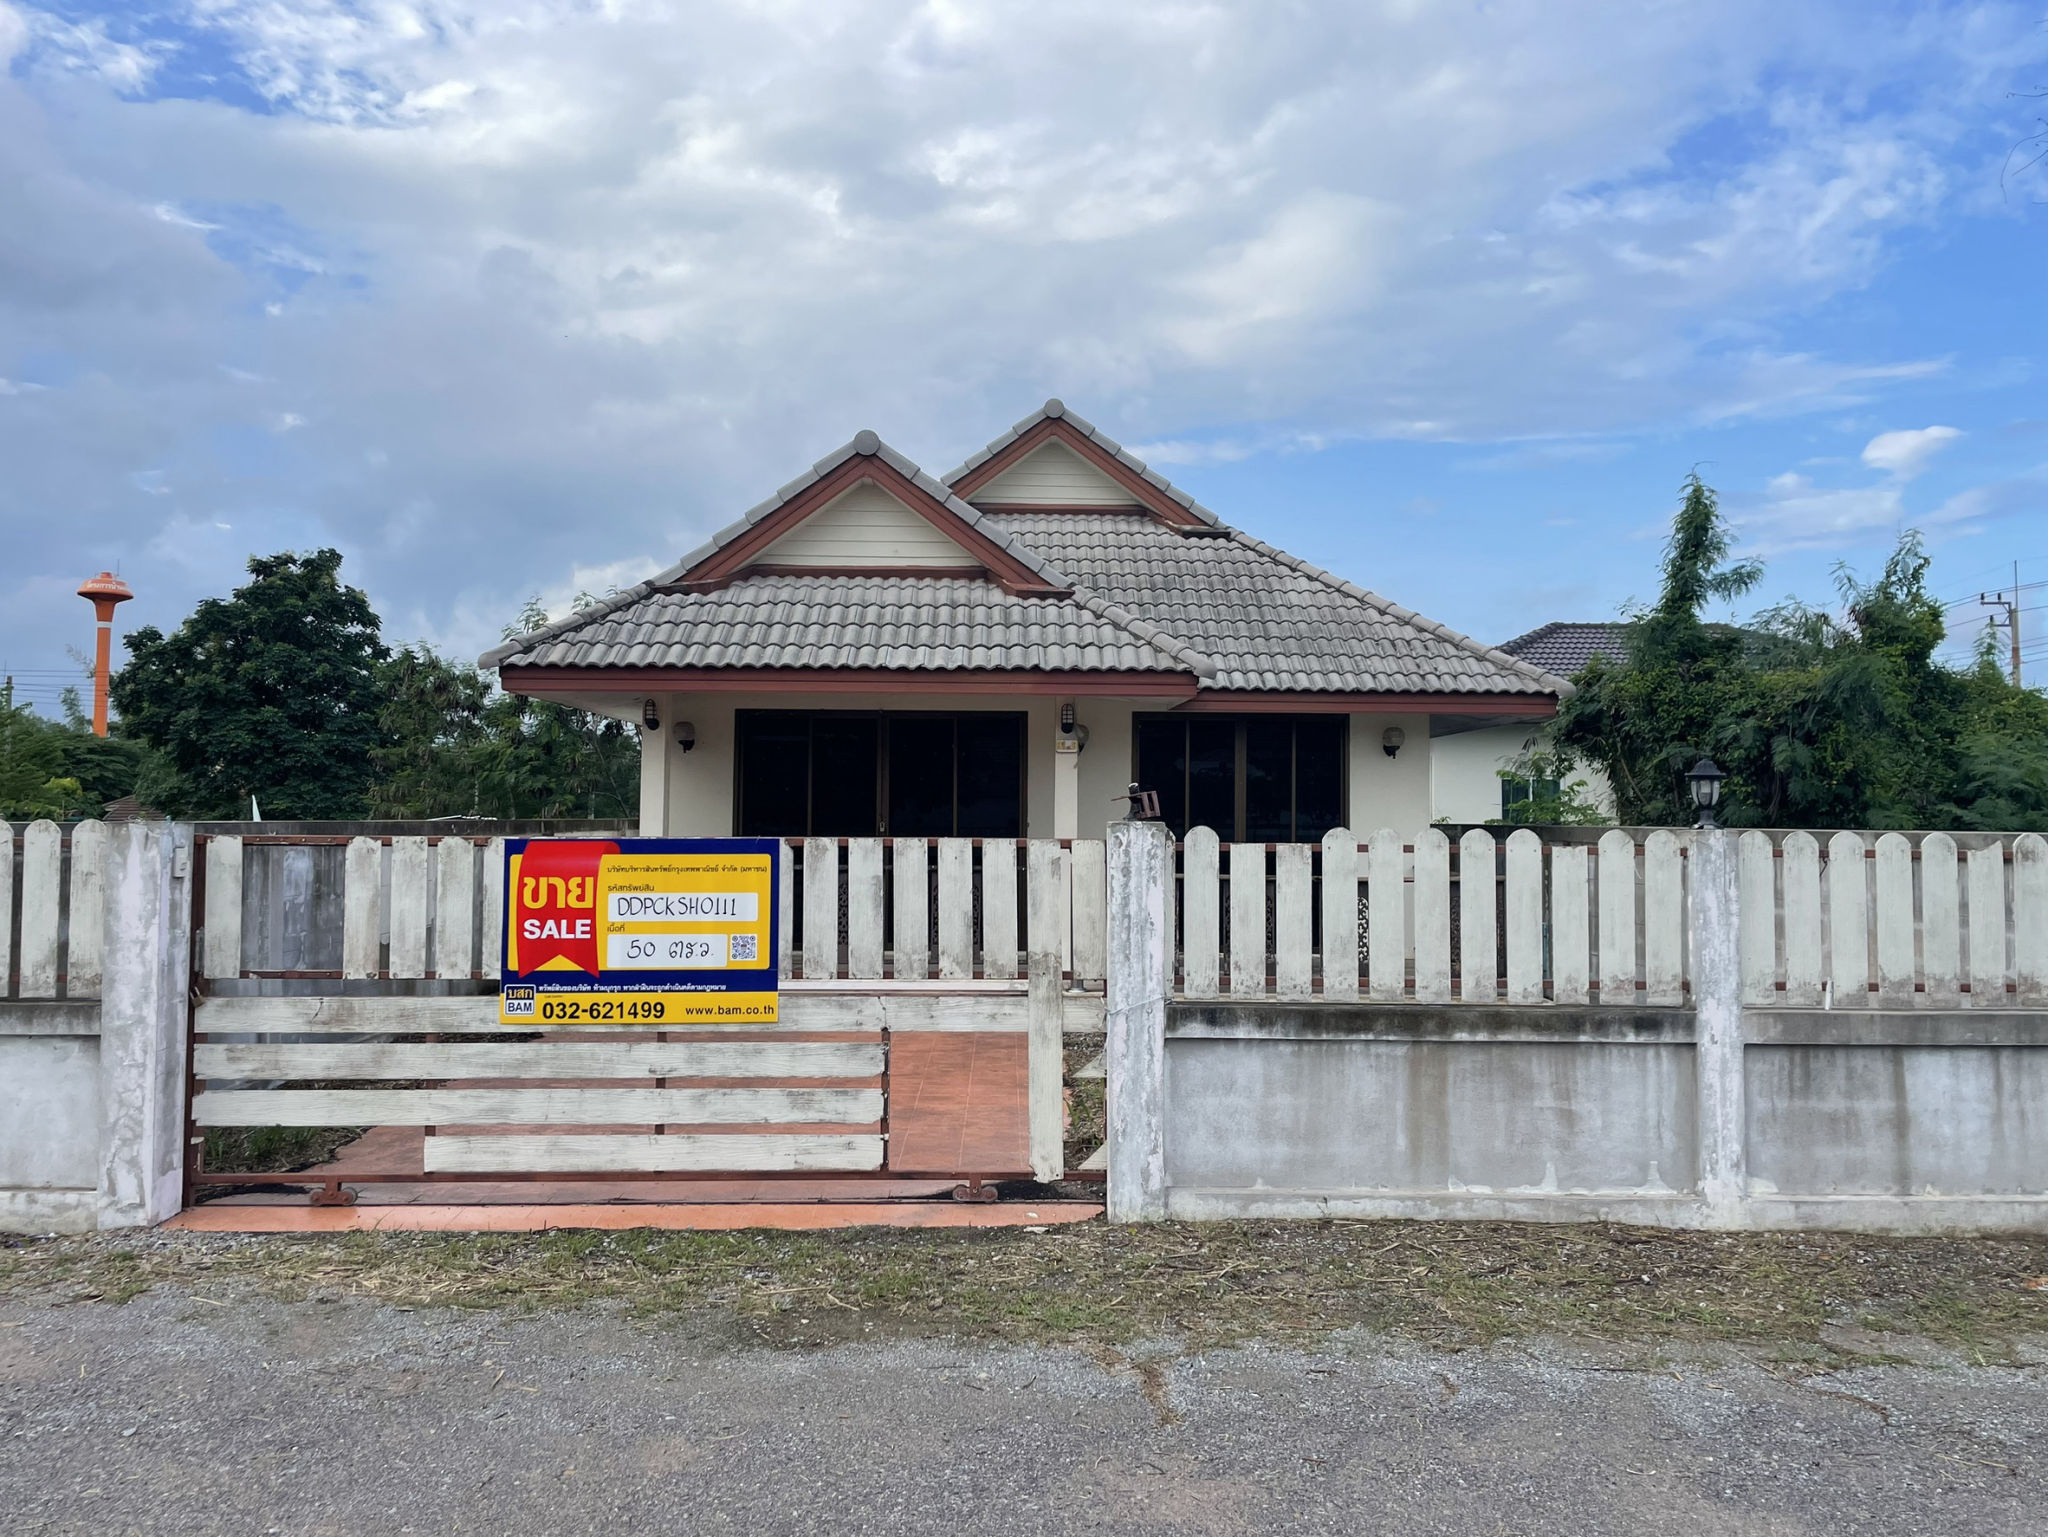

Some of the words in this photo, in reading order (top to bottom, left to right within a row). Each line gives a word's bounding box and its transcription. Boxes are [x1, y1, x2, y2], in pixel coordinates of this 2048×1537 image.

[721, 864, 738, 873] จำกัด
[523, 876, 594, 909] ขาย
[607, 883, 655, 892] รหัสทรัพย์สิน
[523, 919, 592, 939] SALE
[607, 922, 625, 933] เนื้อที่
[627, 939, 656, 959] 50
[507, 987, 533, 999] บสก
[507, 1002, 533, 1013] BAM
[542, 1001, 665, 1020] 032-621499
[685, 1005, 775, 1016] www.bam.co.th
